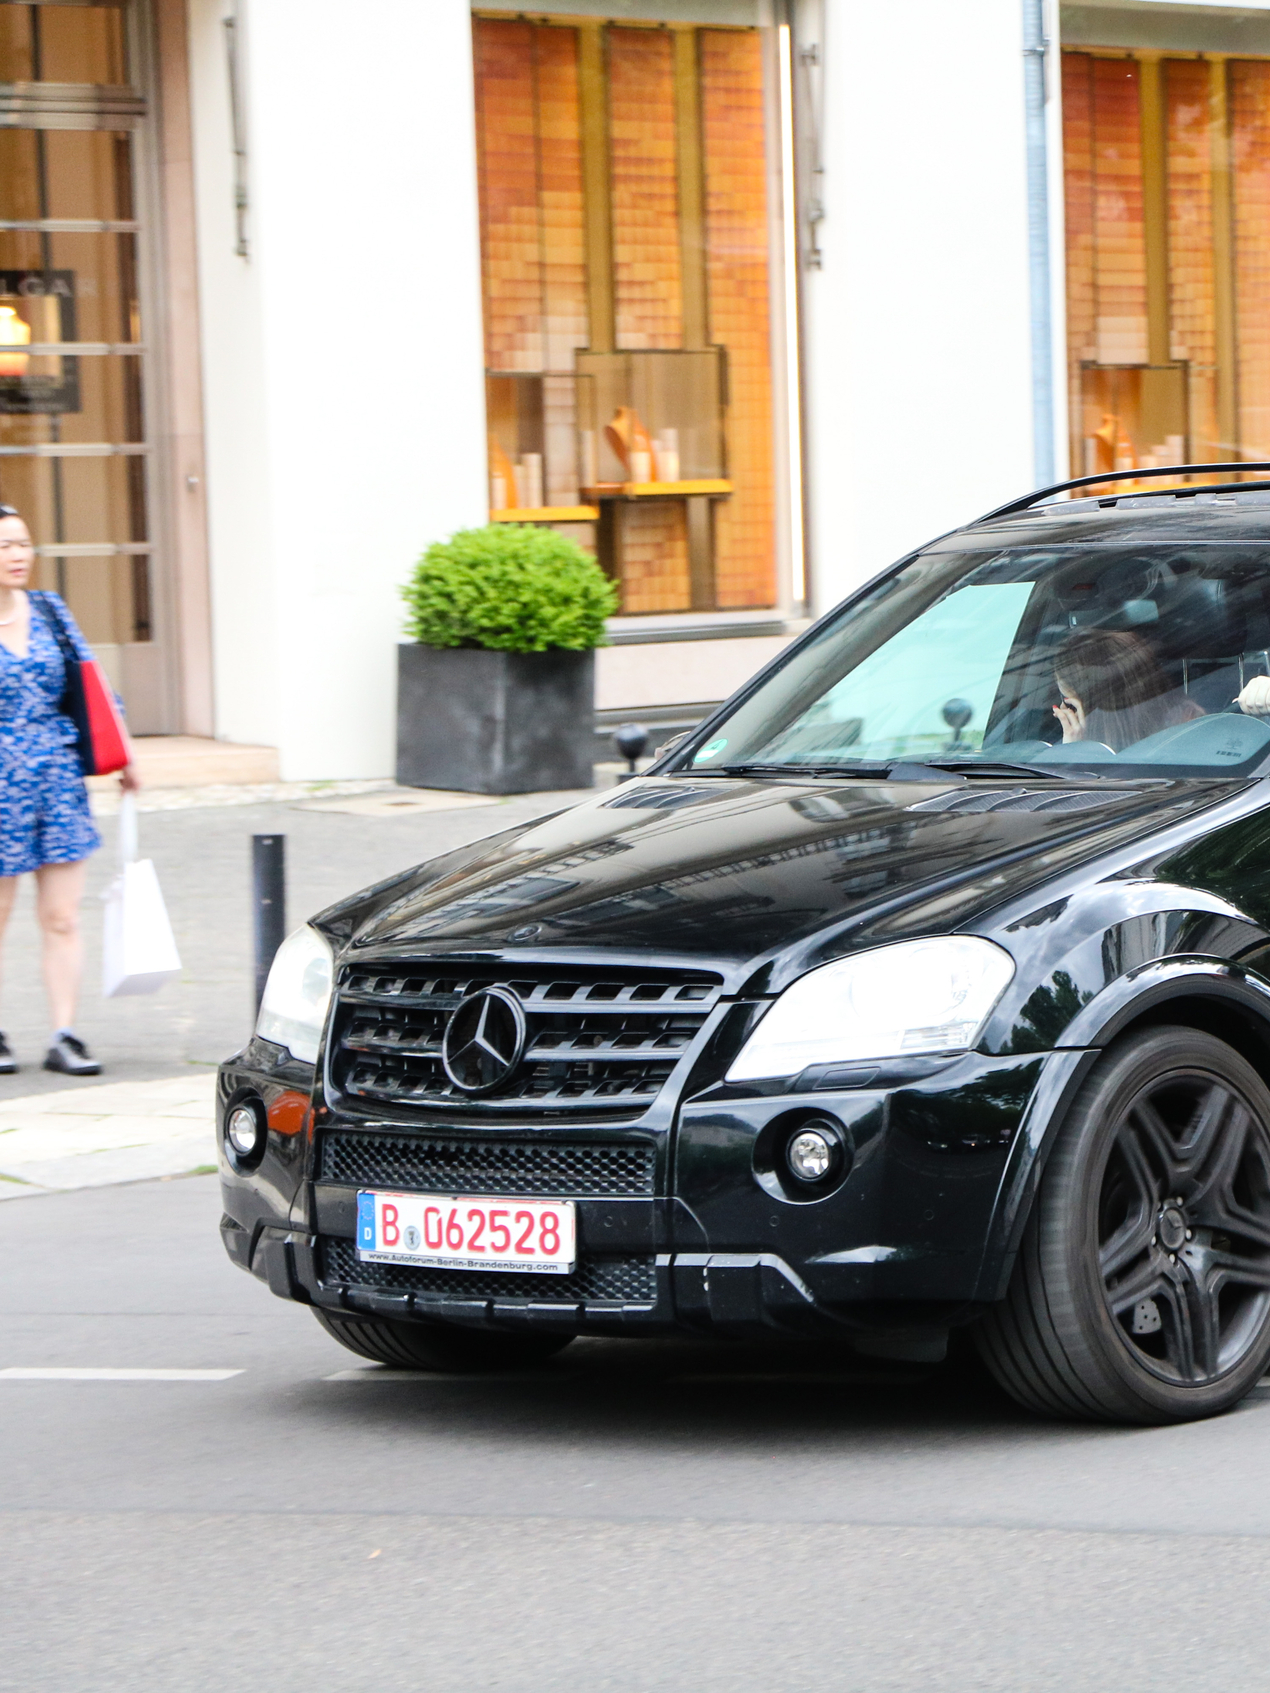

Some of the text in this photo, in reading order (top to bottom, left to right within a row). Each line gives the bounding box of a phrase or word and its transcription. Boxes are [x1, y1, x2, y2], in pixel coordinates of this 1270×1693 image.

[364, 1227, 372, 1240] D
[382, 1203, 561, 1256] B 062528
[368, 1253, 558, 1271] www.Autoforum-Berlin-Brandenburg.com
